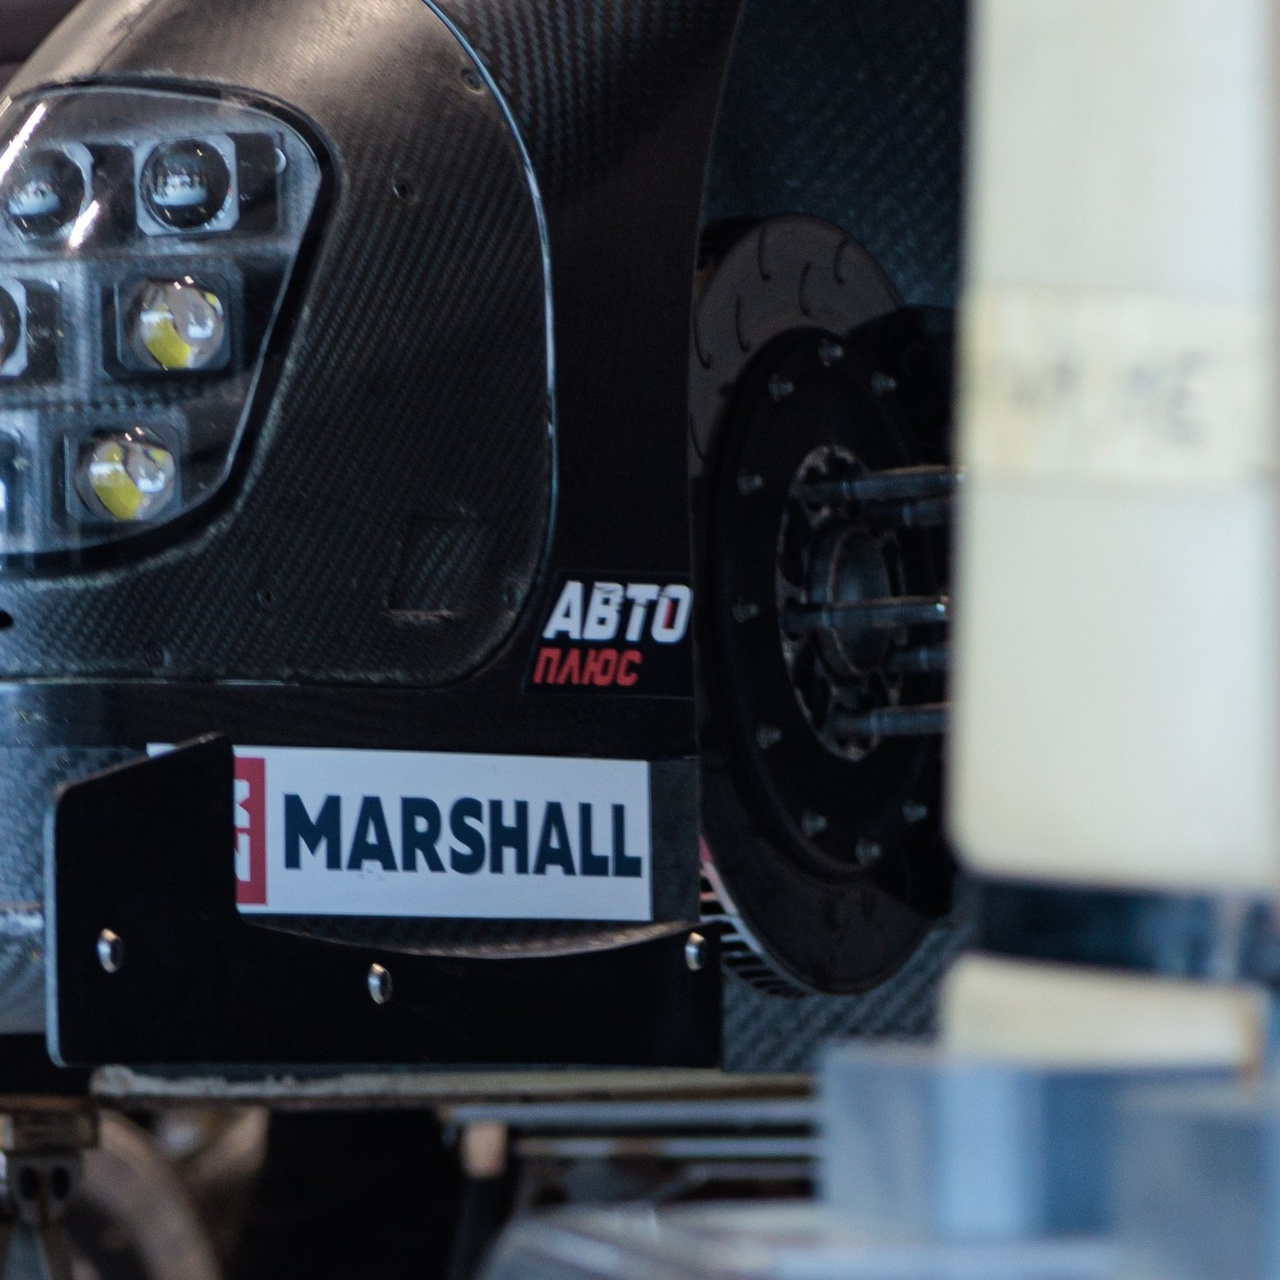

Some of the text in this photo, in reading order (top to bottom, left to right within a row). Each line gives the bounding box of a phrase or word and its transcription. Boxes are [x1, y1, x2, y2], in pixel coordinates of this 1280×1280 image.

[542, 580, 694, 643] АВТО
[532, 647, 643, 687] ПЛЮС
[283, 793, 642, 878] MARSHALL
